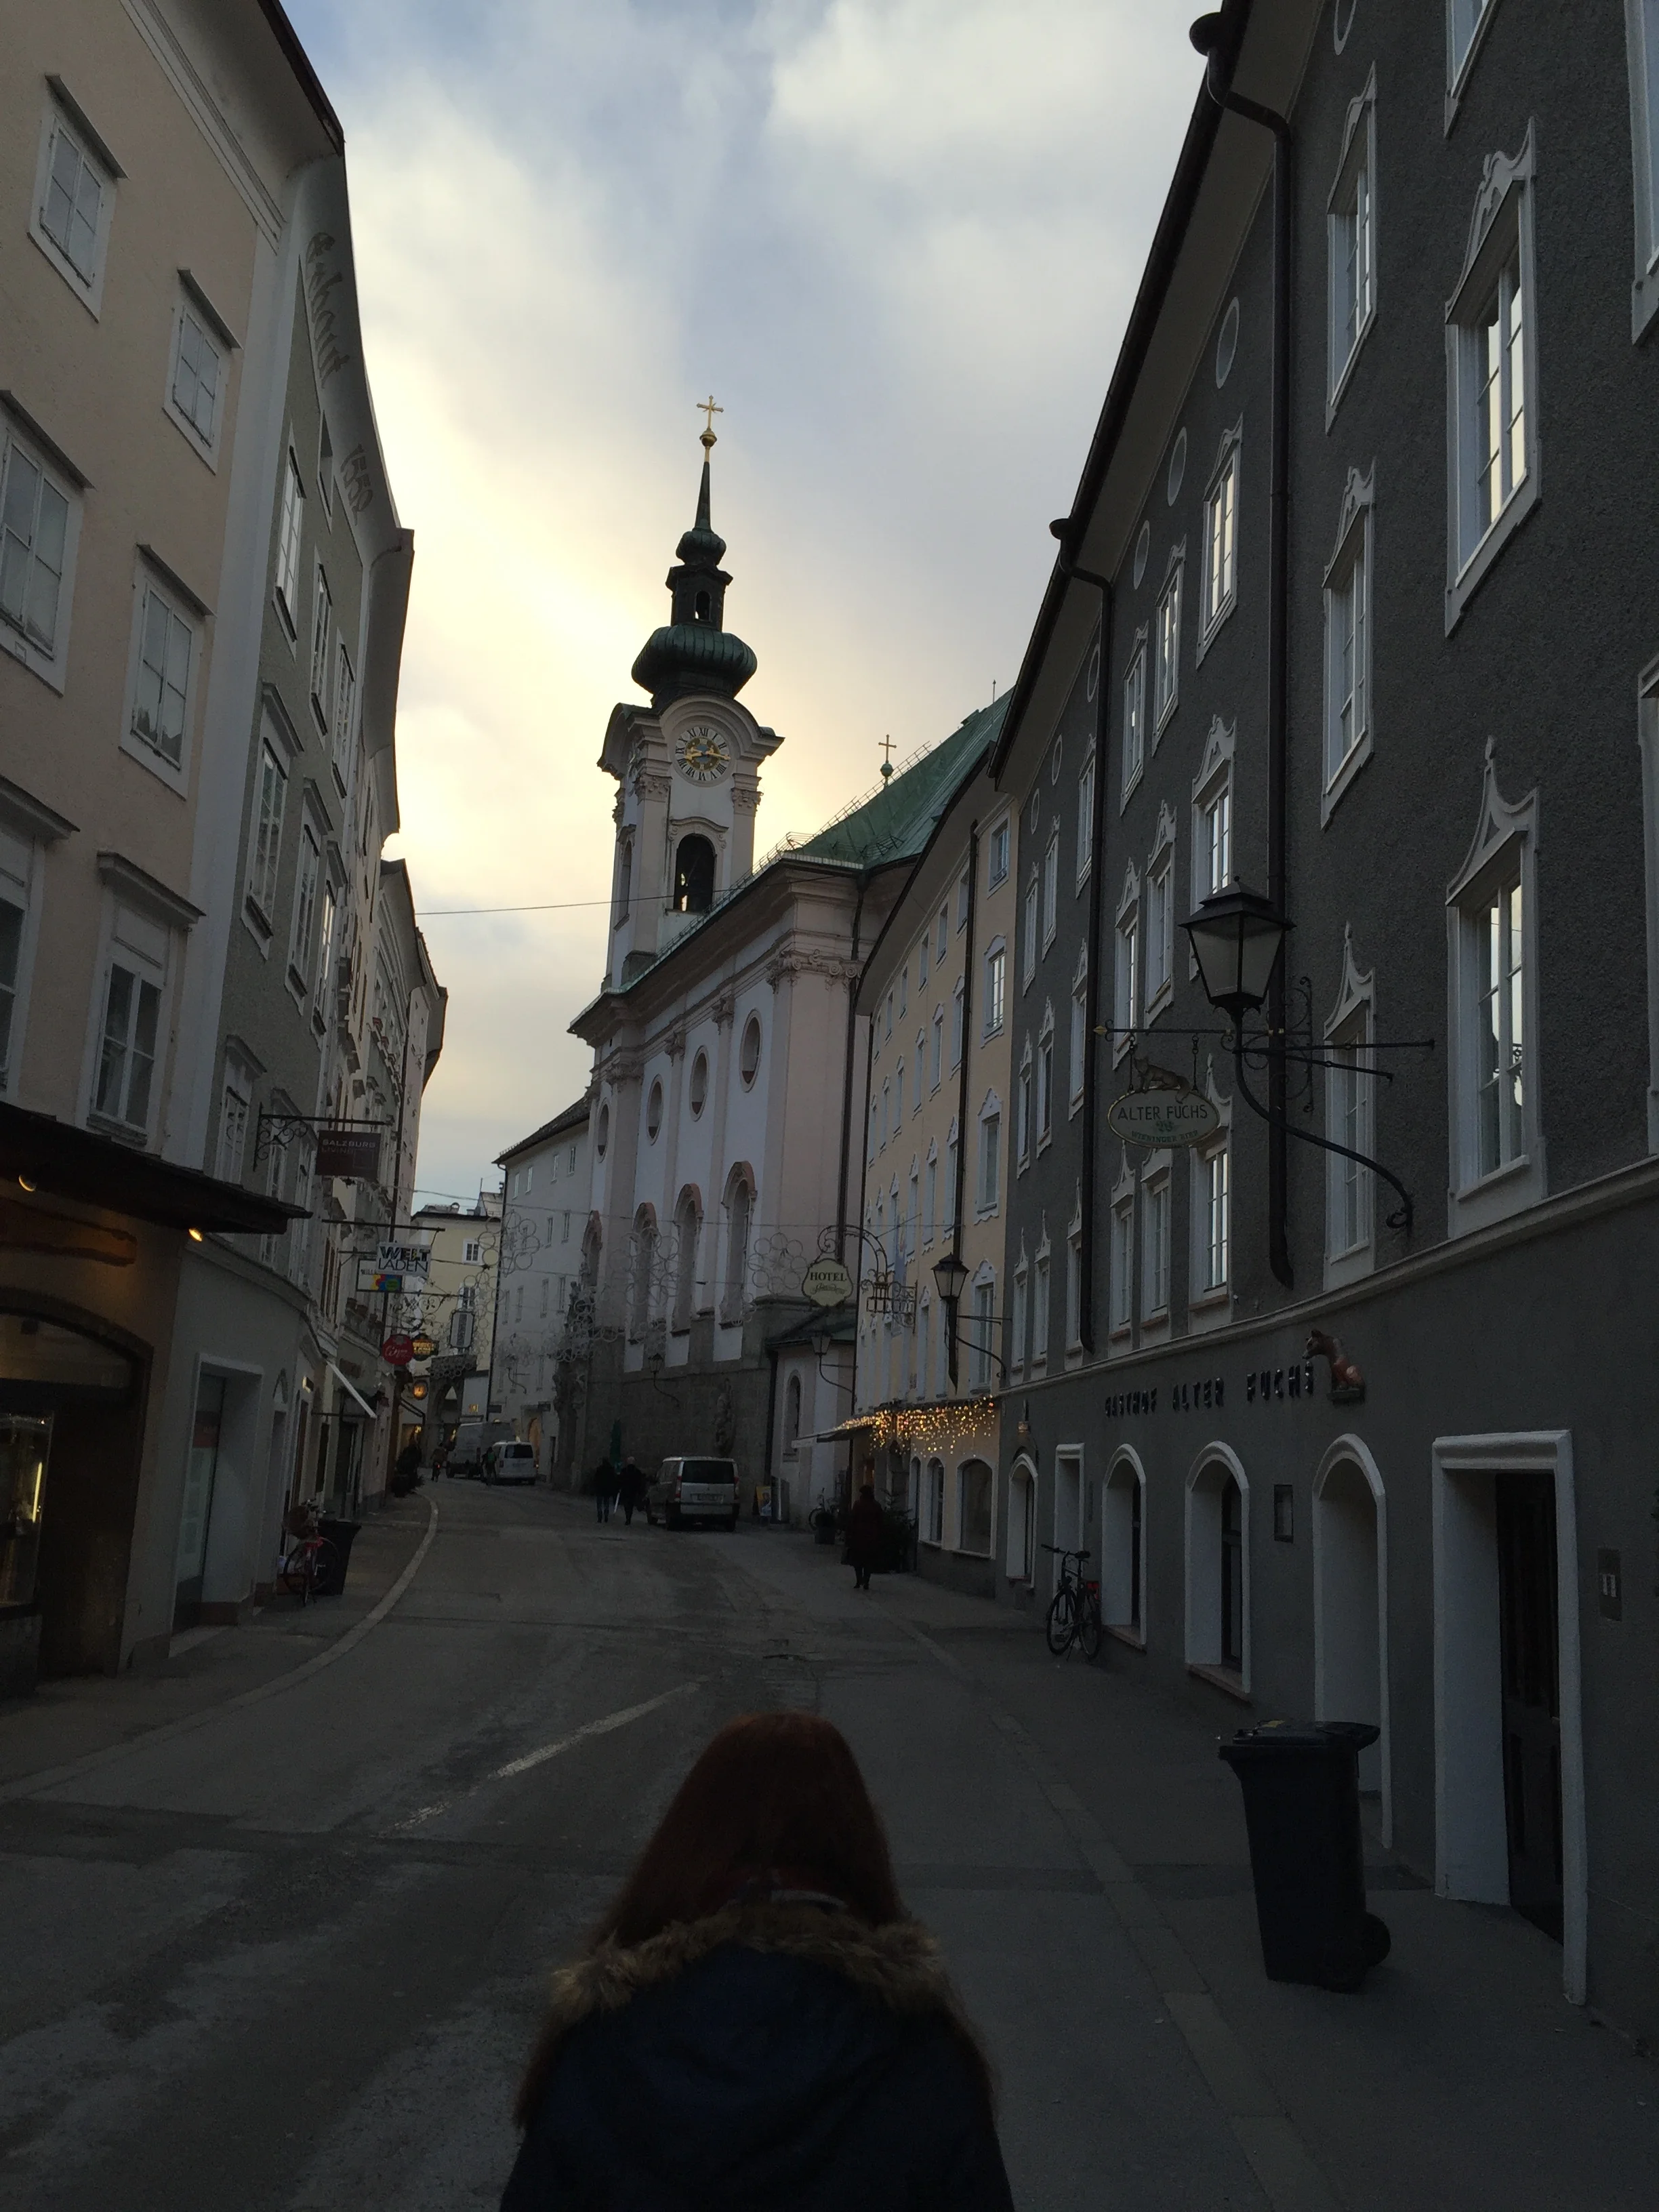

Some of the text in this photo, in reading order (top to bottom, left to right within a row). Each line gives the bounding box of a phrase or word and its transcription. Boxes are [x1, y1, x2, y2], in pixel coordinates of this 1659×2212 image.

[1118, 1104, 1208, 1121] ALTER FUCHS
[322, 1139, 376, 1148] SALZBURG
[380, 1246, 430, 1261] WELT
[378, 1258, 428, 1273] LADEN
[810, 1272, 847, 1282] HOTEL
[1105, 1361, 1314, 1418] GASTHOF ALTER FUCHS
